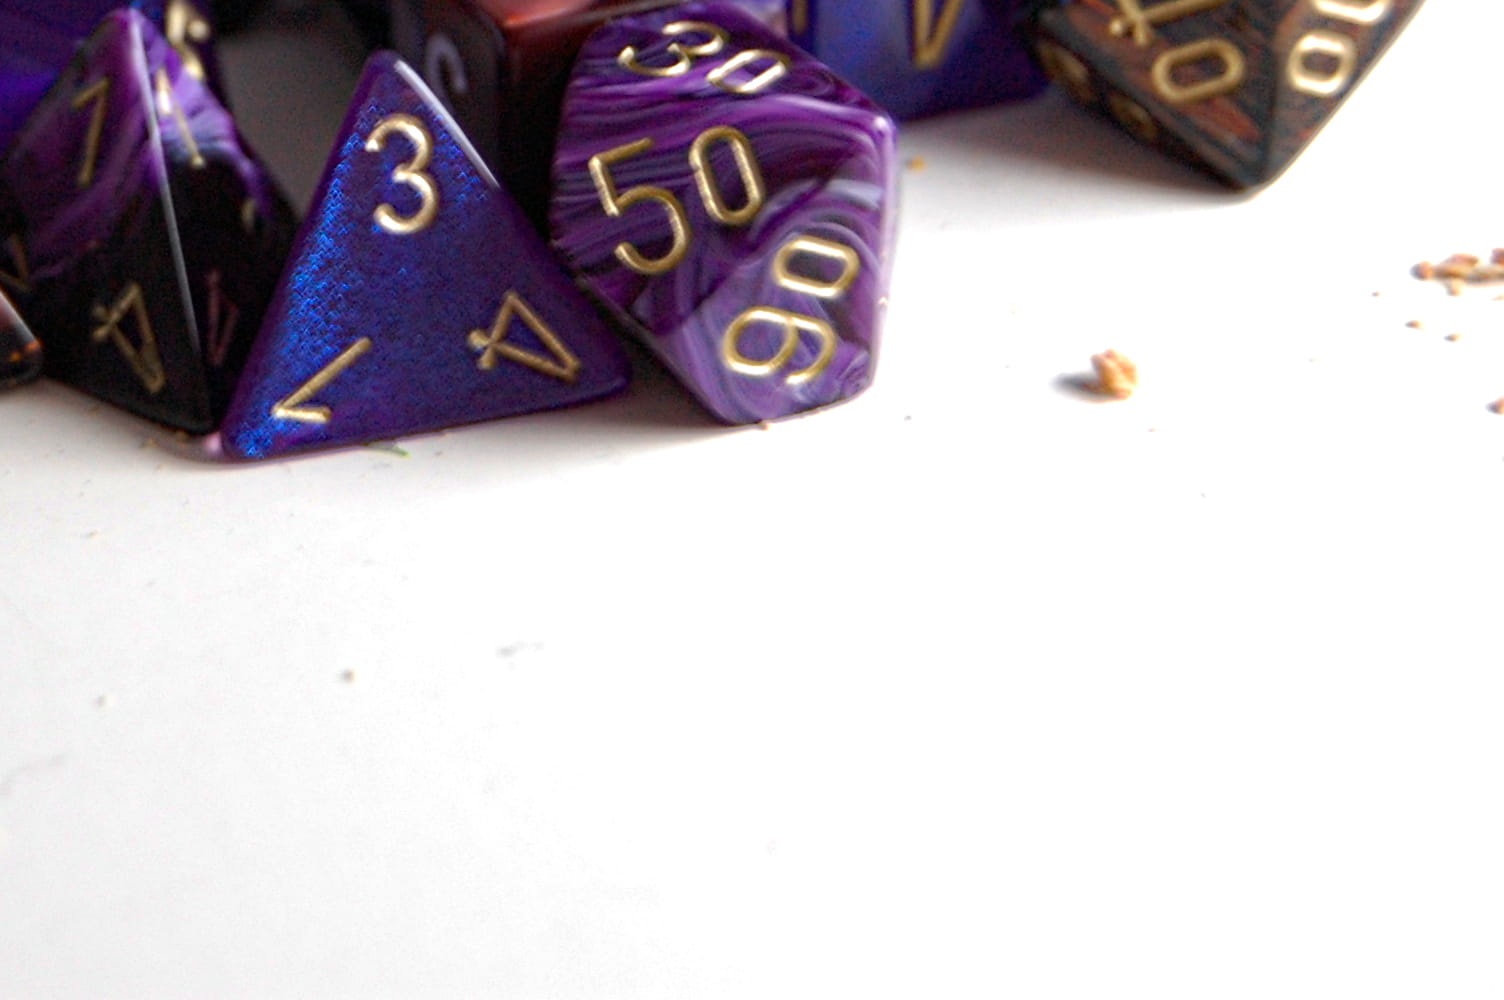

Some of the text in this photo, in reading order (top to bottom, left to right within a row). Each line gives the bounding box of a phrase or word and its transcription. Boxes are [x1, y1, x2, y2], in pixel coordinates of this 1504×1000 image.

[618, 20, 794, 94] 30
[364, 113, 439, 235] 3
[588, 124, 766, 275] 50
[94, 282, 166, 394] 4
[271, 337, 373, 424] 1
[467, 292, 581, 384] 4
